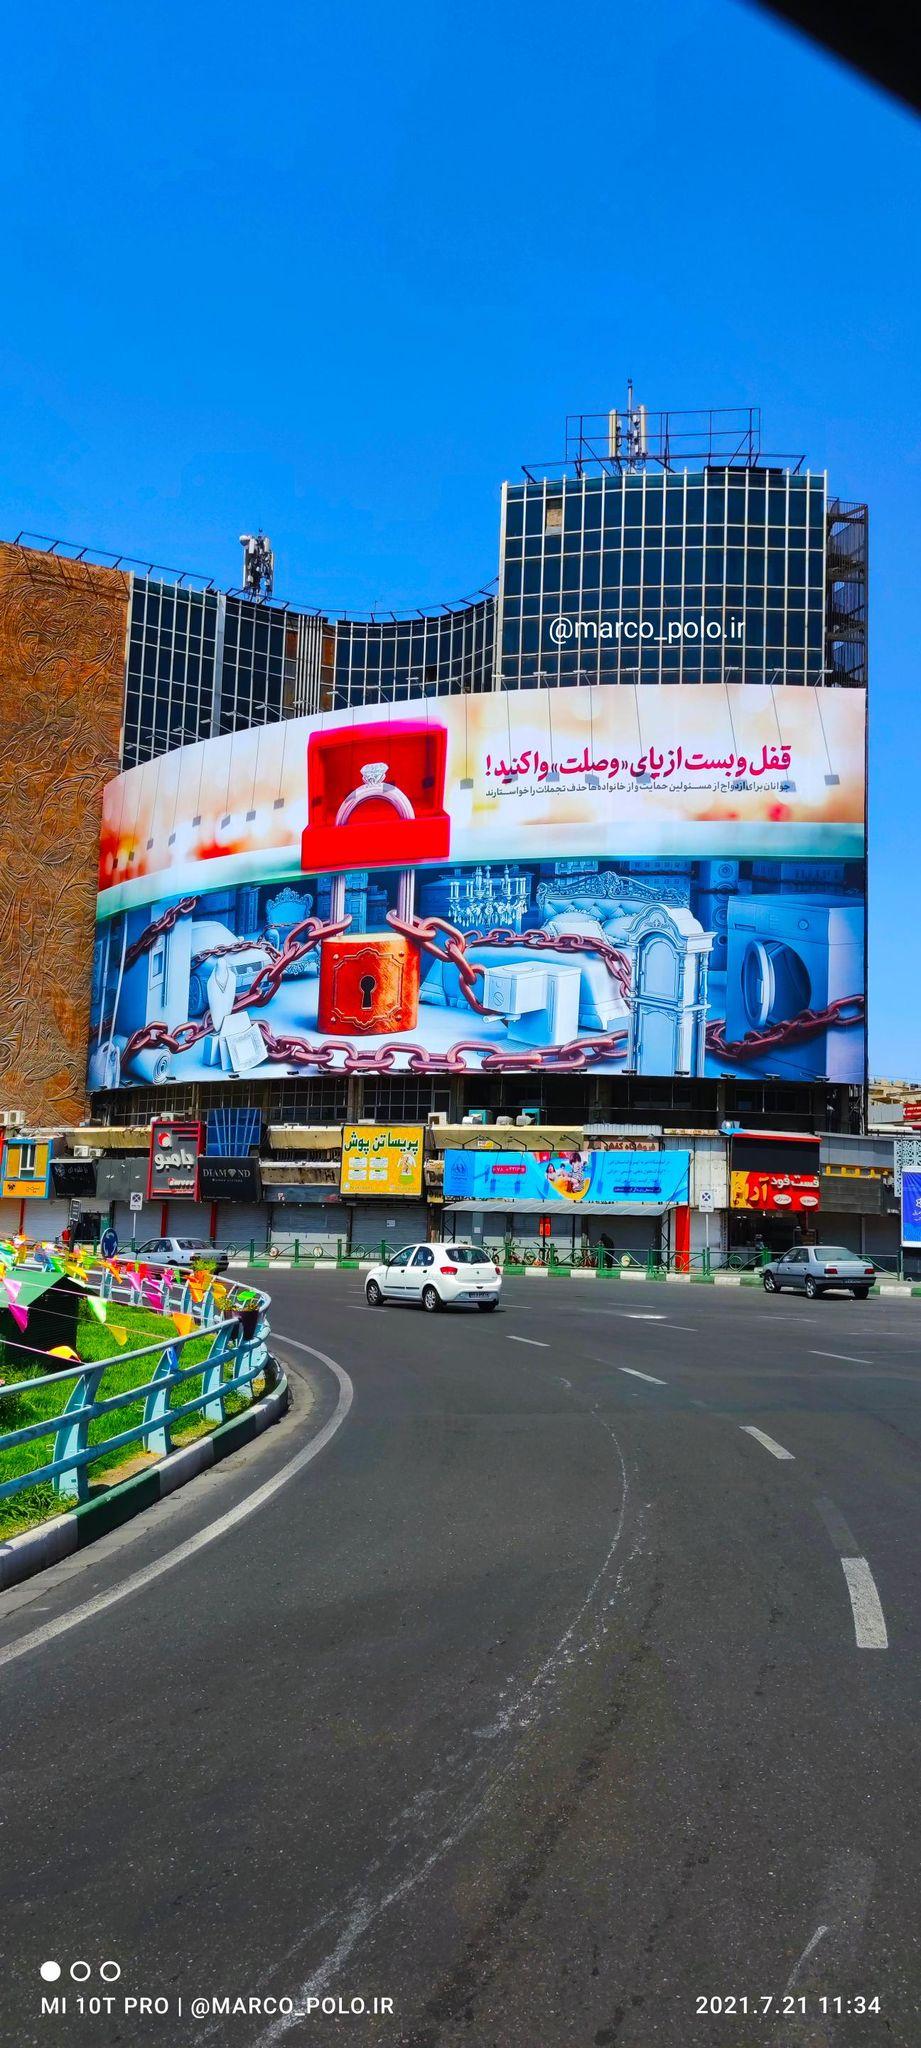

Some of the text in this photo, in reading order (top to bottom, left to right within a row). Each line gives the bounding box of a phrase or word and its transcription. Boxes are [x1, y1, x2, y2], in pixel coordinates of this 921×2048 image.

[630, 745, 665, 781] پای
[663, 745, 683, 778] از
[684, 752, 735, 778] بست
[734, 755, 748, 778] و
[749, 744, 792, 777] قفل
[529, 786, 536, 797] را
[535, 785, 567, 796] تجملات
[566, 784, 587, 793] حذف
[638, 781, 668, 793] حمایت
[712, 780, 720, 792] از
[720, 780, 747, 793] ازدواج
[747, 779, 764, 793] برای
[763, 778, 791, 793] جوانان
[344, 1132, 419, 1155] پریسا تن پوش
[154, 1149, 195, 1170] بامبو
[770, 1174, 791, 1189] فود
[791, 1174, 820, 1188] فست
